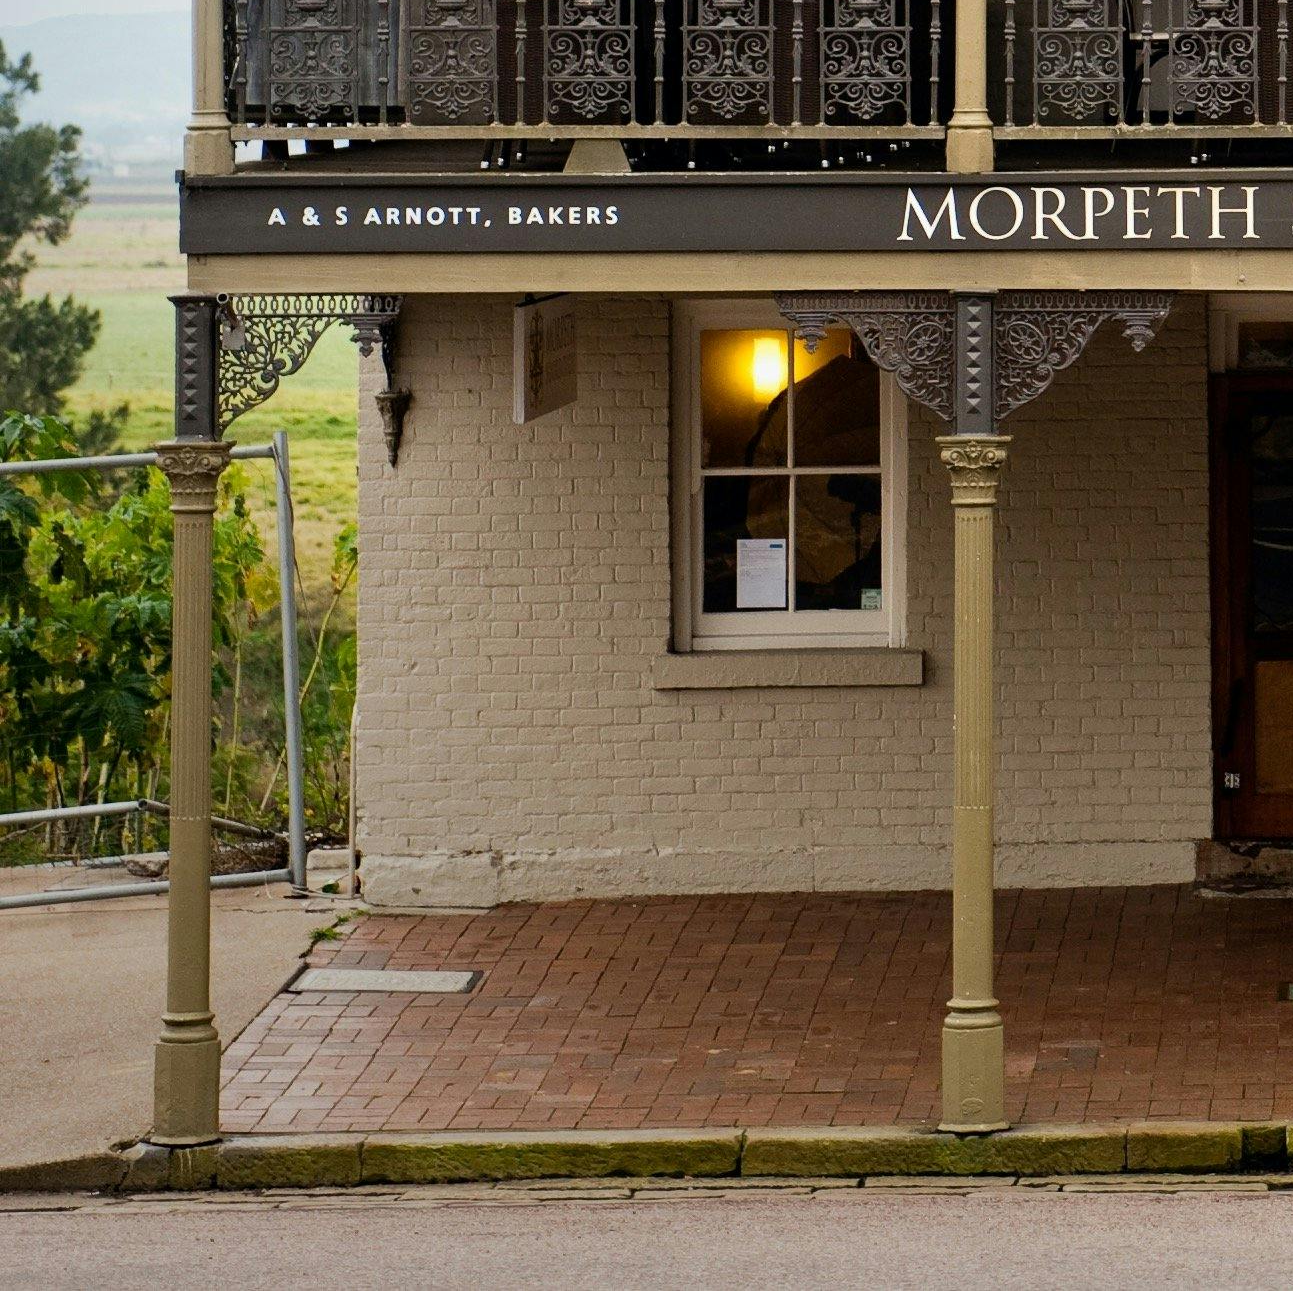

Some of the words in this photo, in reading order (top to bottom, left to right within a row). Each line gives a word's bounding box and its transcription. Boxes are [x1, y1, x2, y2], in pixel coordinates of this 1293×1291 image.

[267, 207, 286, 226] A
[302, 206, 321, 226] &
[335, 206, 348, 226] S
[363, 206, 492, 228] ARNOTT,
[508, 206, 619, 225] BAKERS
[896, 186, 1261, 241] MORPETH
